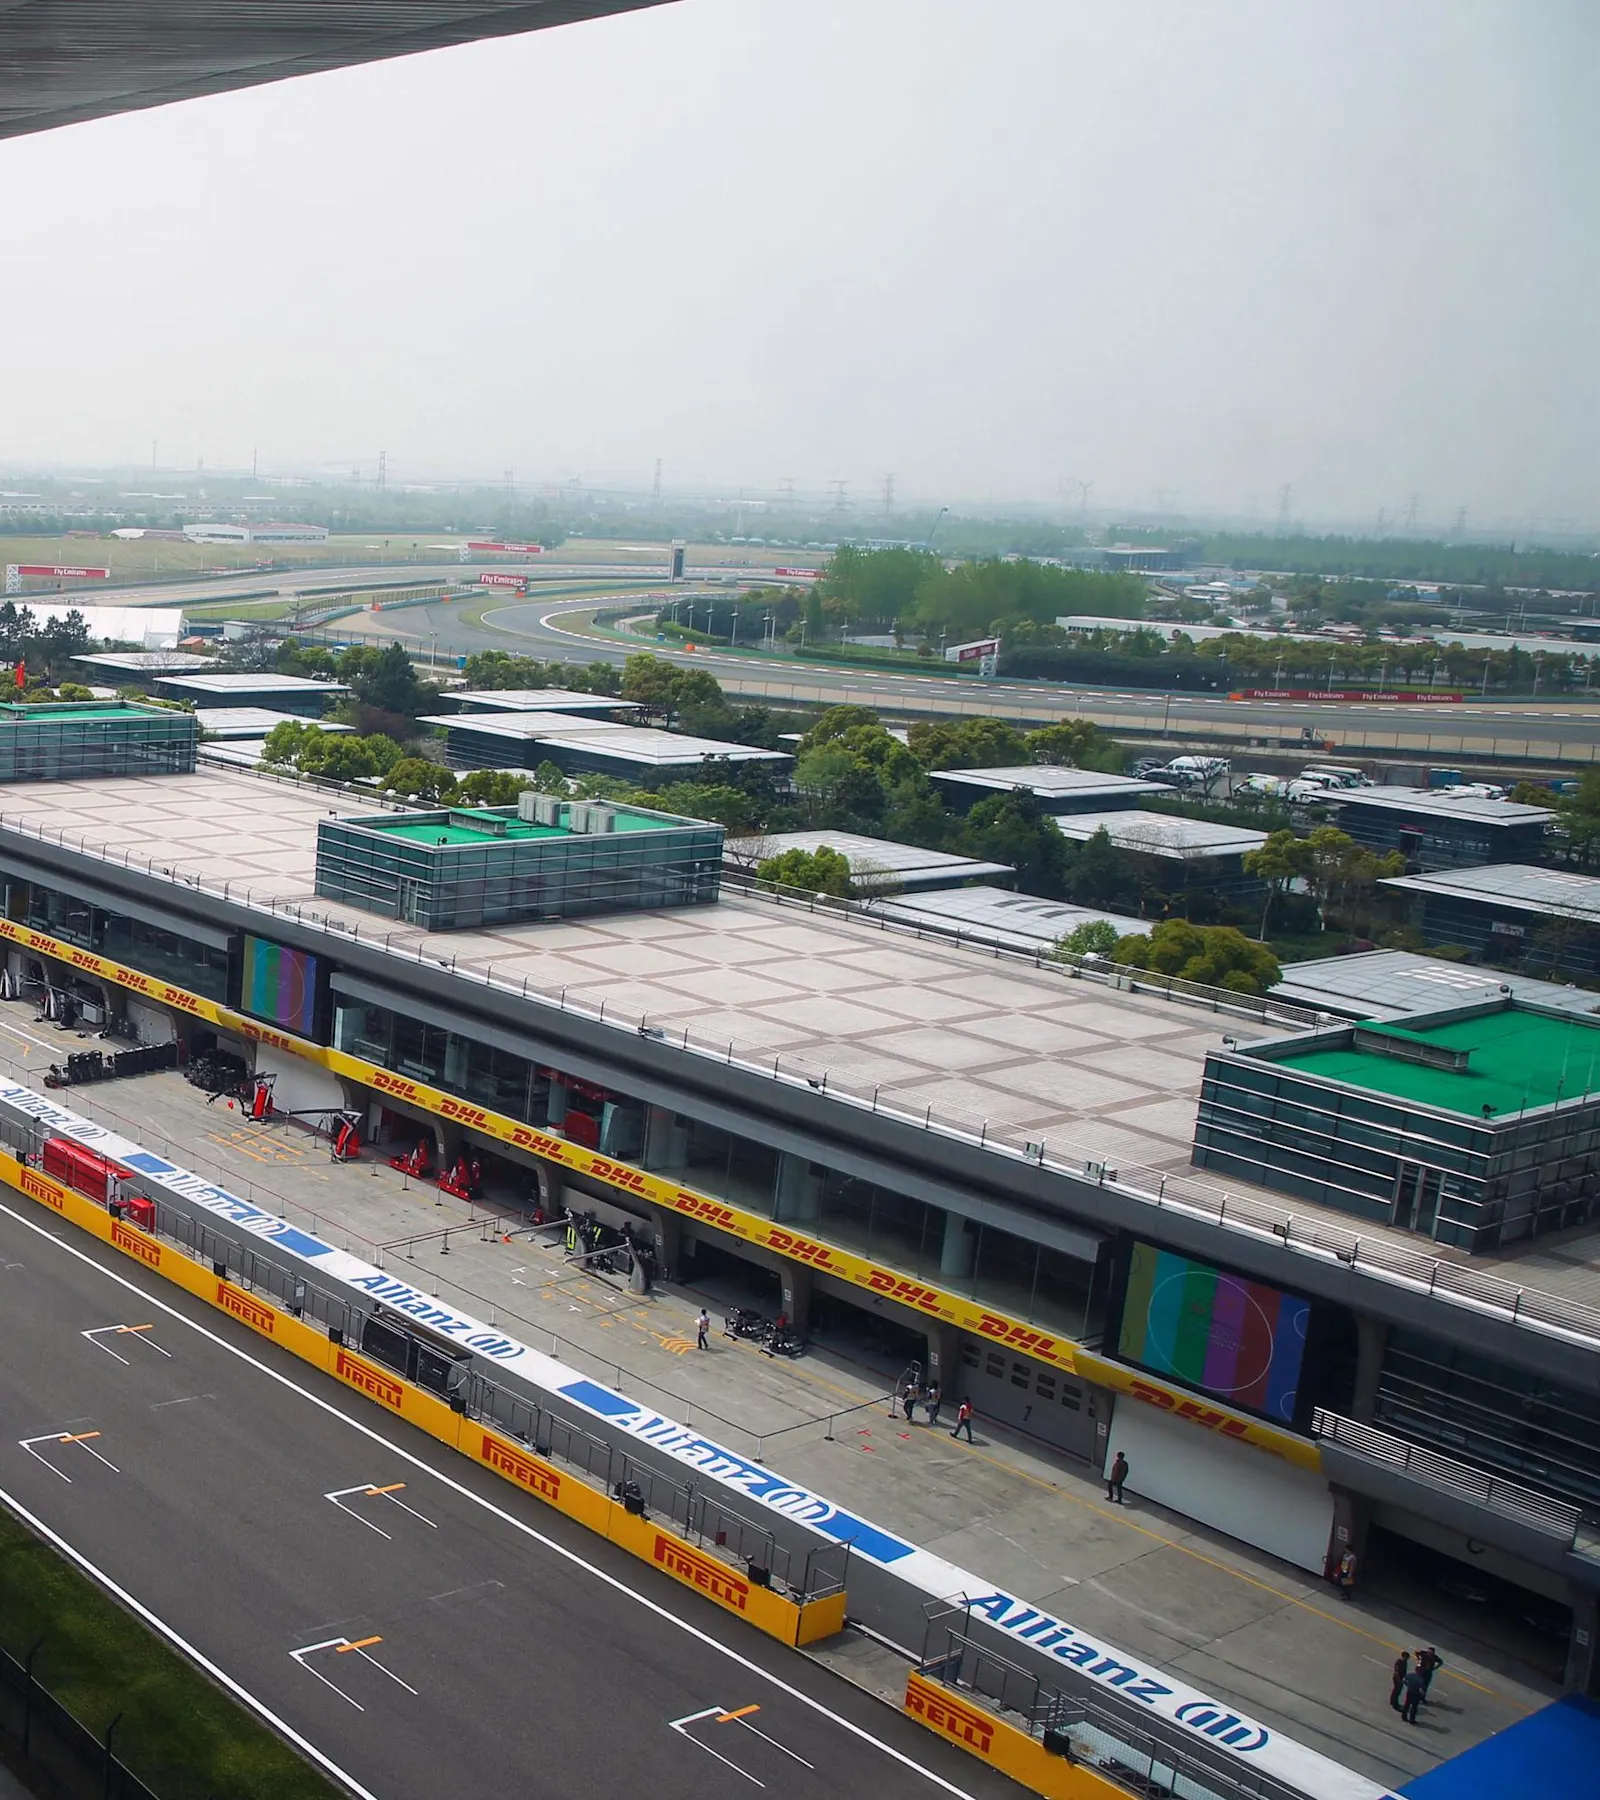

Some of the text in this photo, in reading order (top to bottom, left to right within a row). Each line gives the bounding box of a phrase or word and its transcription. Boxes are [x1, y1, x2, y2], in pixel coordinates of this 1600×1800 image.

[481, 574, 493, 584] Fly
[1254, 690, 1264, 698] Fly
[1308, 691, 1318, 699] Fly
[30, 935, 58, 954] DHL
[72, 951, 101, 971] DHL
[117, 969, 149, 992] DHL
[165, 988, 199, 1012] DHL
[241, 1022, 298, 1055] DHL
[372, 1072, 418, 1101] DHL
[441, 1099, 489, 1129] DHL
[512, 1129, 565, 1160] DHL
[21, 1169, 64, 1211] PIRELLI
[152, 1171, 250, 1219] Allianz
[590, 1159, 646, 1193] DHL
[674, 1193, 736, 1229] DHL
[111, 1222, 161, 1267] PIRELLI
[766, 1230, 834, 1269] DHL
[217, 1283, 275, 1335] PIRELLI
[349, 1274, 473, 1335] Allianz
[868, 1270, 941, 1313] DHL
[977, 1314, 1059, 1360] DHL
[336, 1352, 403, 1409] PIRELLI
[1129, 1380, 1258, 1446] DHL
[482, 1435, 561, 1501] PIRELLI
[608, 1411, 769, 1494] Allianz
[653, 1535, 749, 1611] PIRELLI
[957, 1591, 1174, 1704] Allianz
[904, 1679, 995, 1754] RELLI
